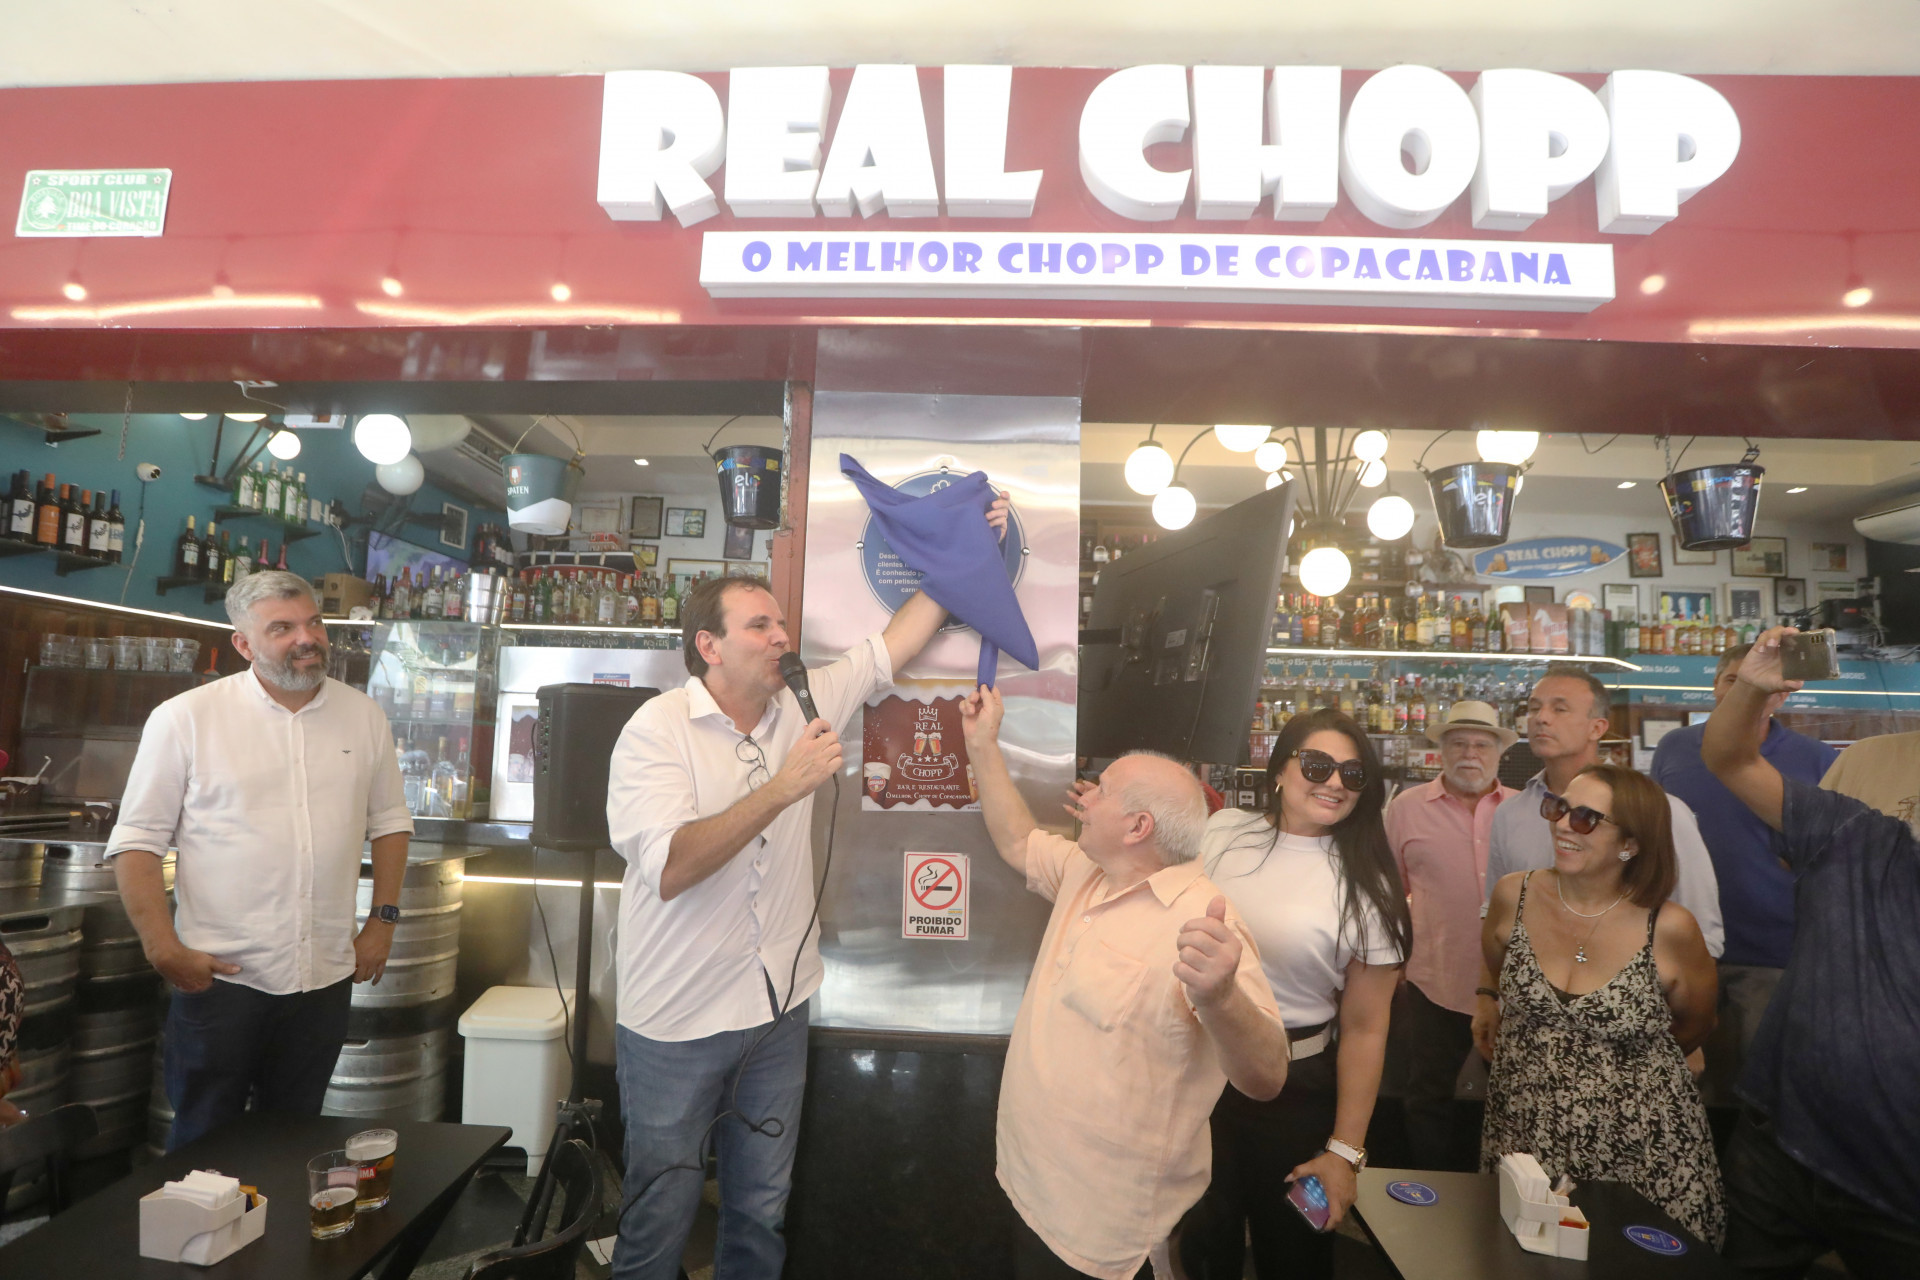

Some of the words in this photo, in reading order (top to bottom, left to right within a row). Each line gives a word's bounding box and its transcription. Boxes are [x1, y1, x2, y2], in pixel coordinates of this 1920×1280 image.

[597, 64, 1043, 226] REAL
[1079, 64, 1741, 234] CHOPP
[48, 175, 102, 186] SPORT
[104, 174, 147, 185] CLUB
[66, 191, 101, 218] BOA
[110, 190, 160, 217] VISTA
[742, 241, 771, 272] O
[787, 241, 982, 273] MELHOR
[998, 242, 1164, 275] CHOPP
[1180, 245, 1239, 276] DE
[1255, 245, 1572, 286] COPACABANA
[507, 486, 529, 495] SPATEN
[1505, 548, 1539, 561] REAL
[1542, 545, 1587, 559] CHOPP
[914, 722, 943, 731] REAL
[913, 768, 942, 777] CHOPP
[909, 916, 961, 925] PROIBIDO
[916, 926, 954, 934] FUMAR
